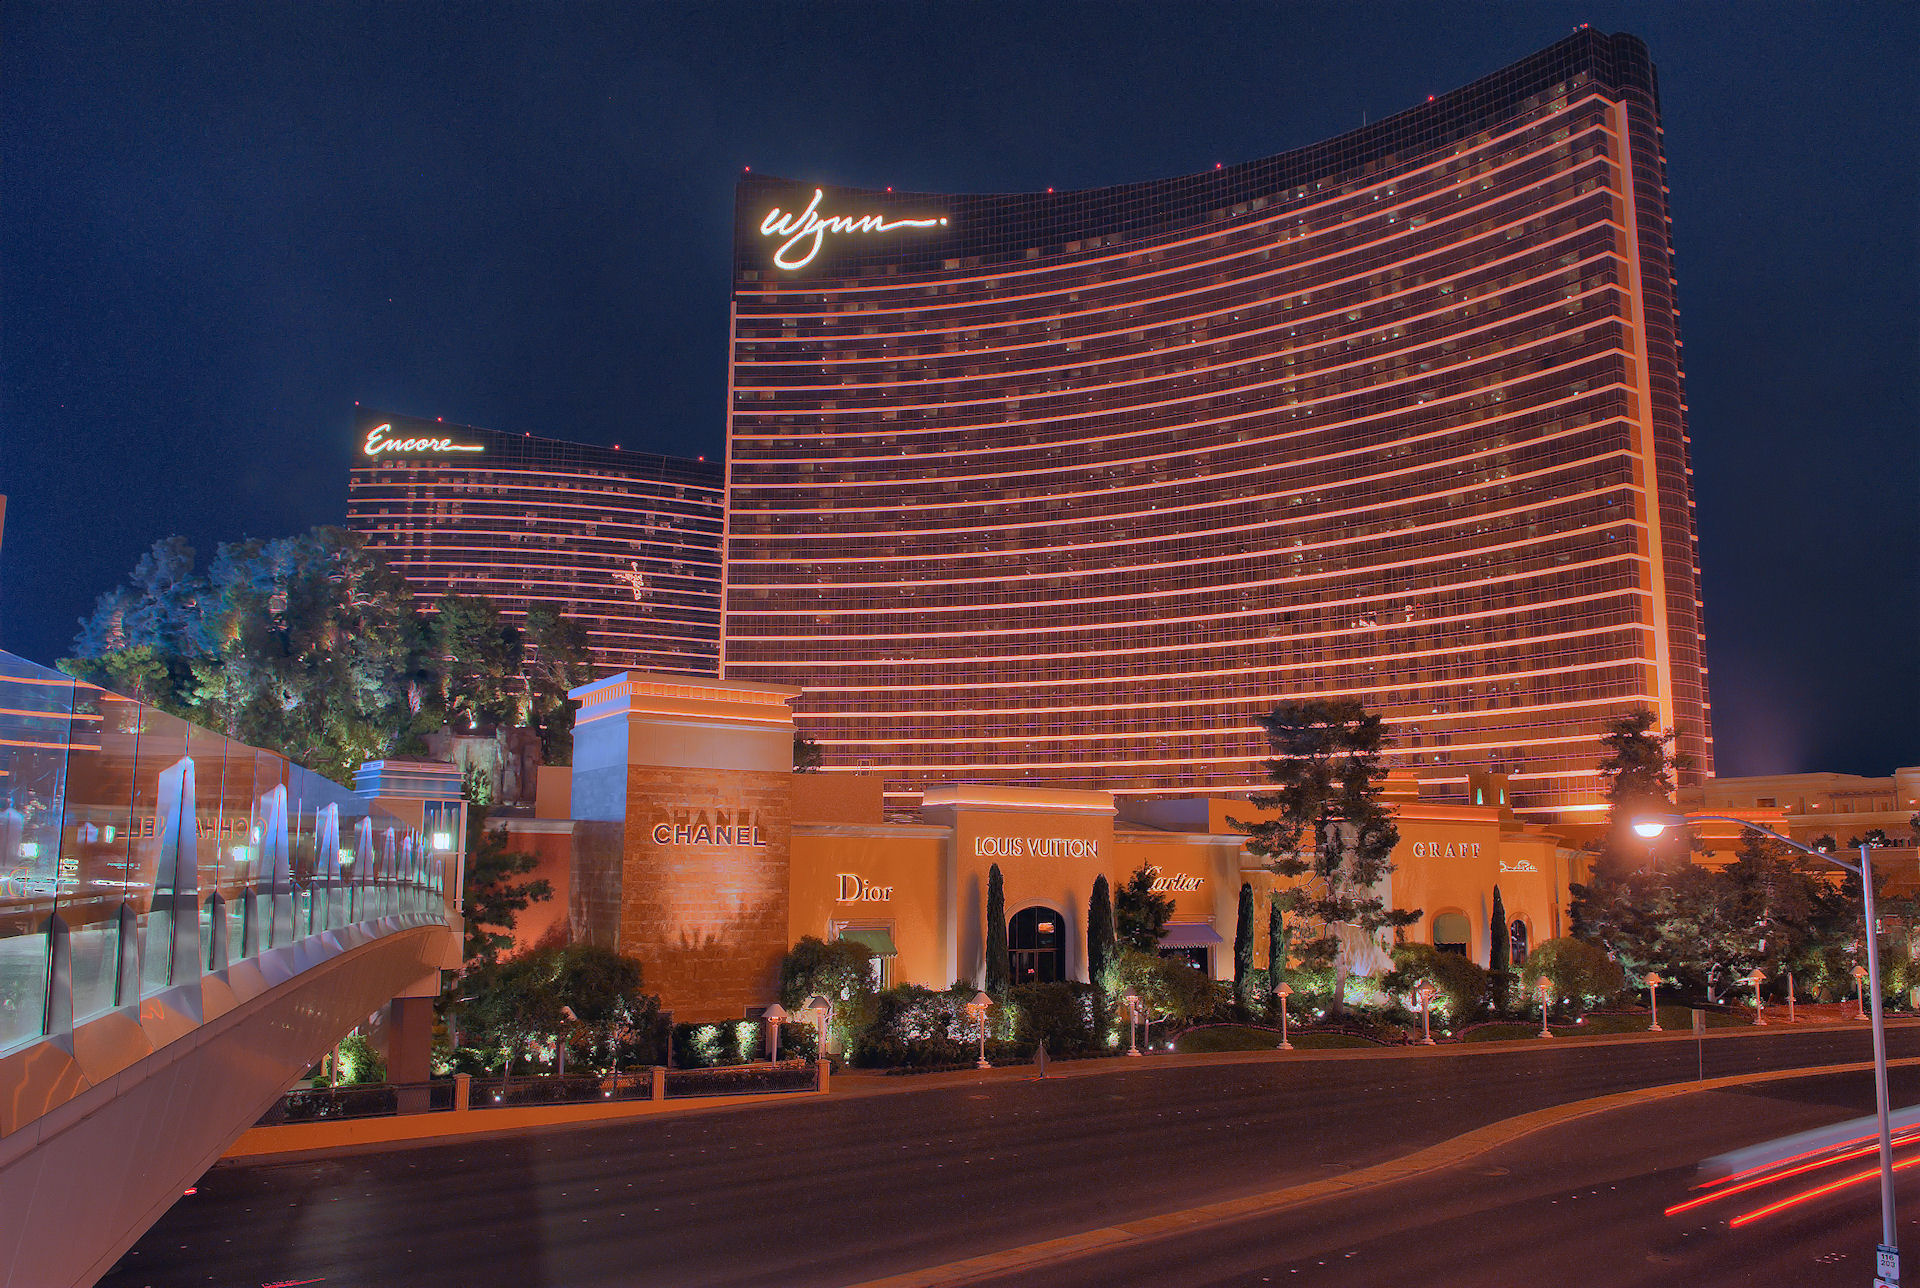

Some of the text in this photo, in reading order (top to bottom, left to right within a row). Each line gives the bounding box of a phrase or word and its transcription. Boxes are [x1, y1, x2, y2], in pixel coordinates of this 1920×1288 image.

[363, 423, 485, 456] Encore
[652, 823, 767, 848] CHANEL
[975, 836, 1099, 859] LOUIS VUITTON
[1412, 841, 1481, 859] GRAFF
[835, 873, 893, 902] Dior
[1144, 865, 1205, 892] Cartier
